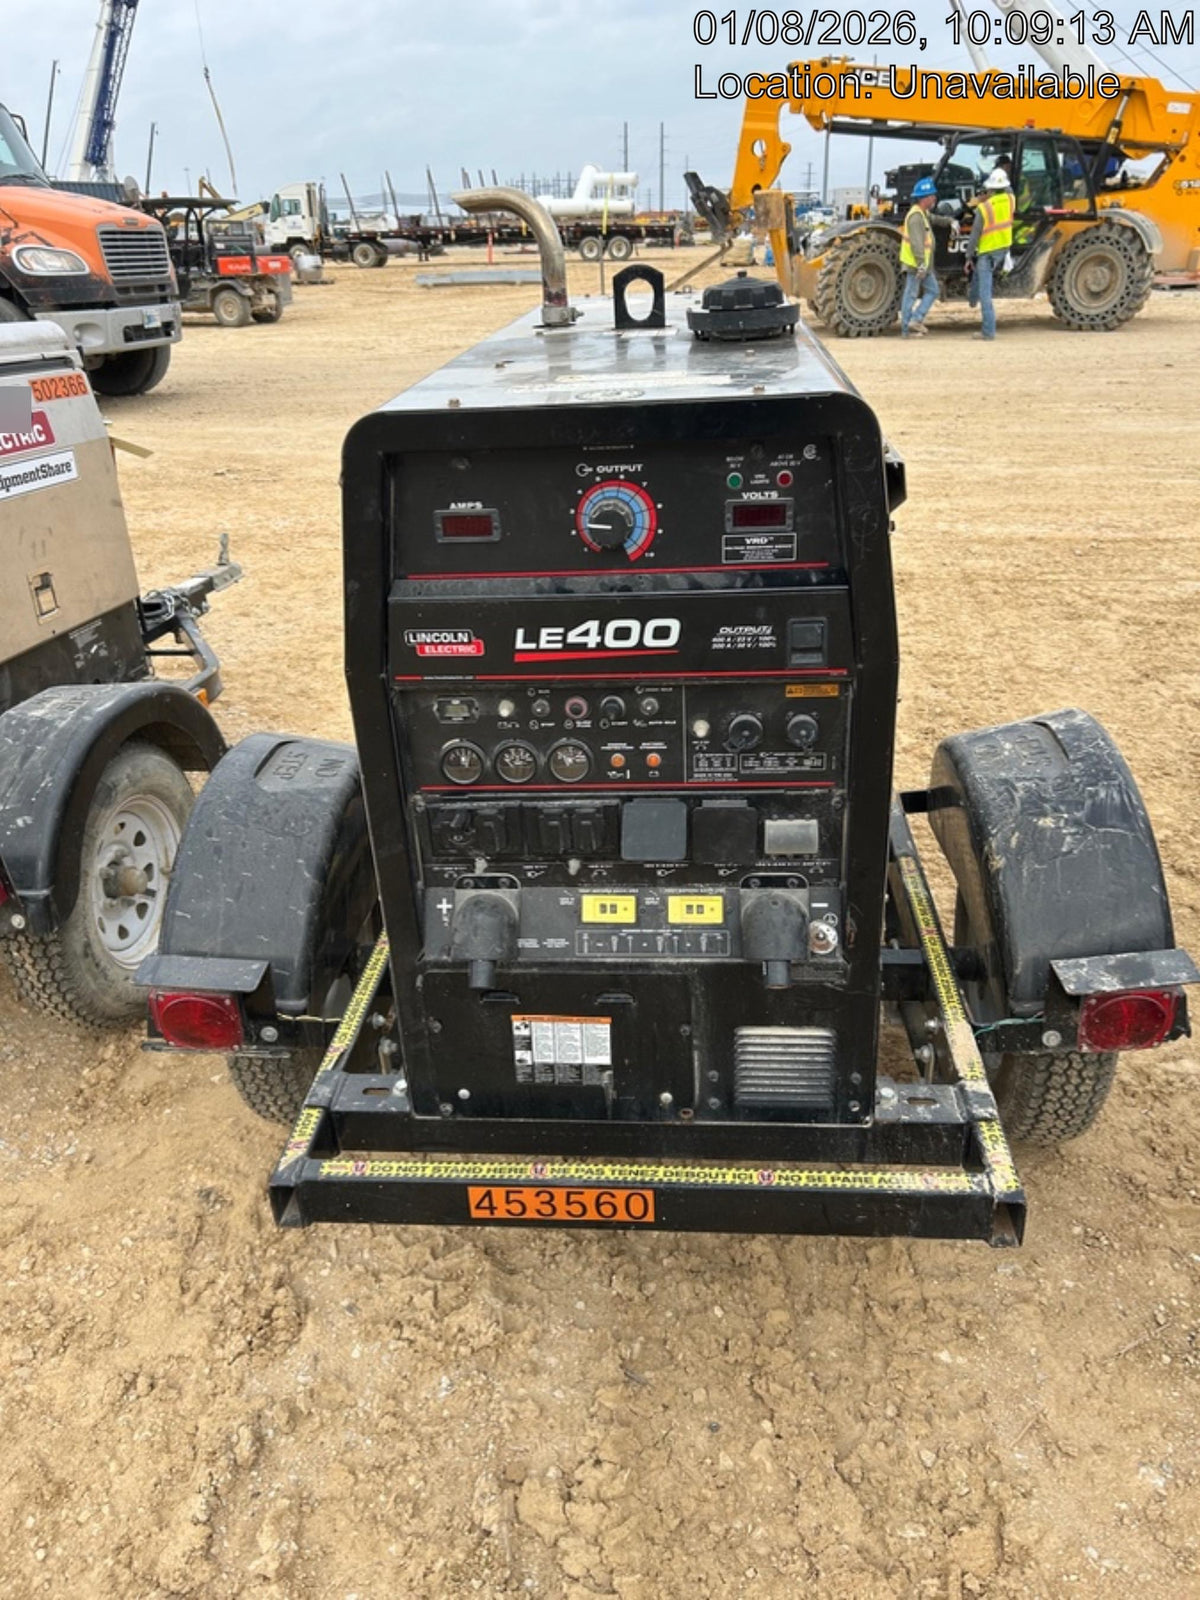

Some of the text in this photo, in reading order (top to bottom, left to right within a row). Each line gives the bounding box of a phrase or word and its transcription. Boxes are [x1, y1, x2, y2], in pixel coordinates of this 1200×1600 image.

[31, 375, 88, 402] 502366
[0, 424, 46, 450] CTRIC
[596, 463, 643, 473] OUTPUT
[0, 461, 72, 493] ipmentShare
[742, 491, 778, 500] VOLTS
[450, 501, 483, 509] AMPS
[408, 632, 469, 643] LINCOLN
[514, 618, 682, 650] LE400
[424, 644, 478, 654] ELECTRIC
[315, 759, 345, 778] NO
[370, 1165, 529, 1175] DO NOT STAND HERE
[549, 1167, 754, 1180] NE PAS TENEZ DEBOUT ICI
[778, 1174, 802, 1183] NO
[805, 1174, 828, 1183] SE
[830, 1175, 874, 1185] PARE
[474, 1189, 649, 1220] 453560
